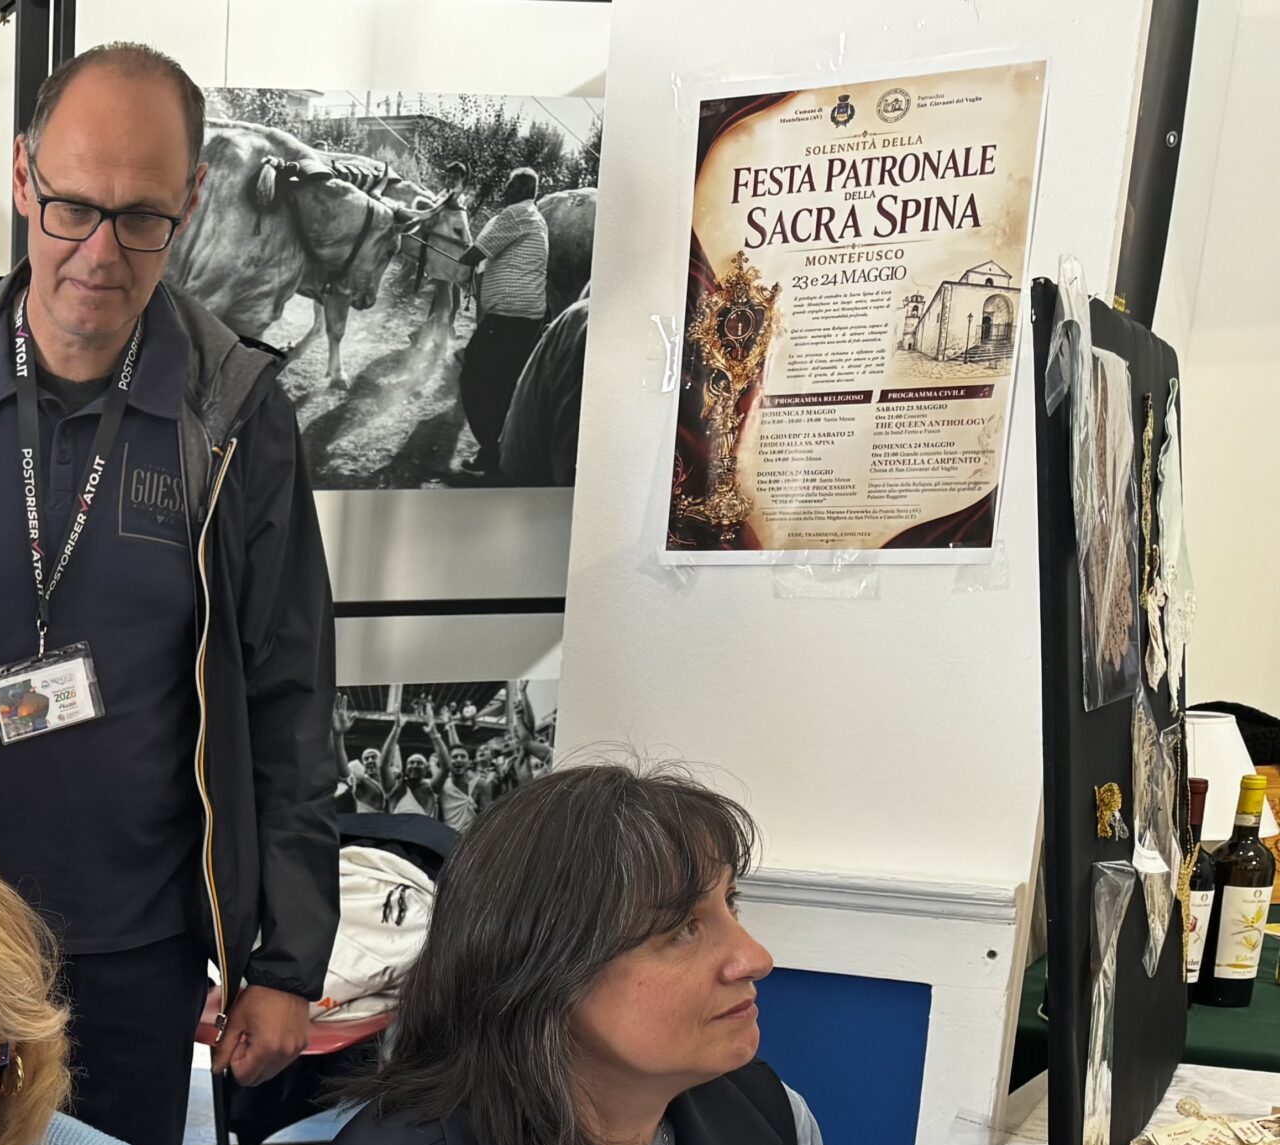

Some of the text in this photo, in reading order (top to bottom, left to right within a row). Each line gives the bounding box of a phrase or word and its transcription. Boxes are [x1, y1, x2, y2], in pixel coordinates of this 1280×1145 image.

[805, 135, 923, 156] SOLENNITÀ DELLA
[732, 144, 997, 204] FESTA PATRONALE
[844, 190, 876, 201] DELLA
[744, 193, 982, 249] SACRA SPINA
[805, 249, 905, 267] MONTEFUSCO
[792, 265, 907, 290] 23 e 24 MAGGIO
[775, 394, 864, 404] PROGRAMMA RELIGIOSO
[888, 391, 938, 399] PROGRAMMA
[762, 410, 799, 418] DOMENICA
[895, 420, 926, 429] QUEEN
[928, 418, 986, 427] ANTHOLOGY
[871, 457, 981, 466] ANTONELLA CARPENITO
[757, 470, 794, 478] DOMENICA
[131, 468, 184, 513] GUES
